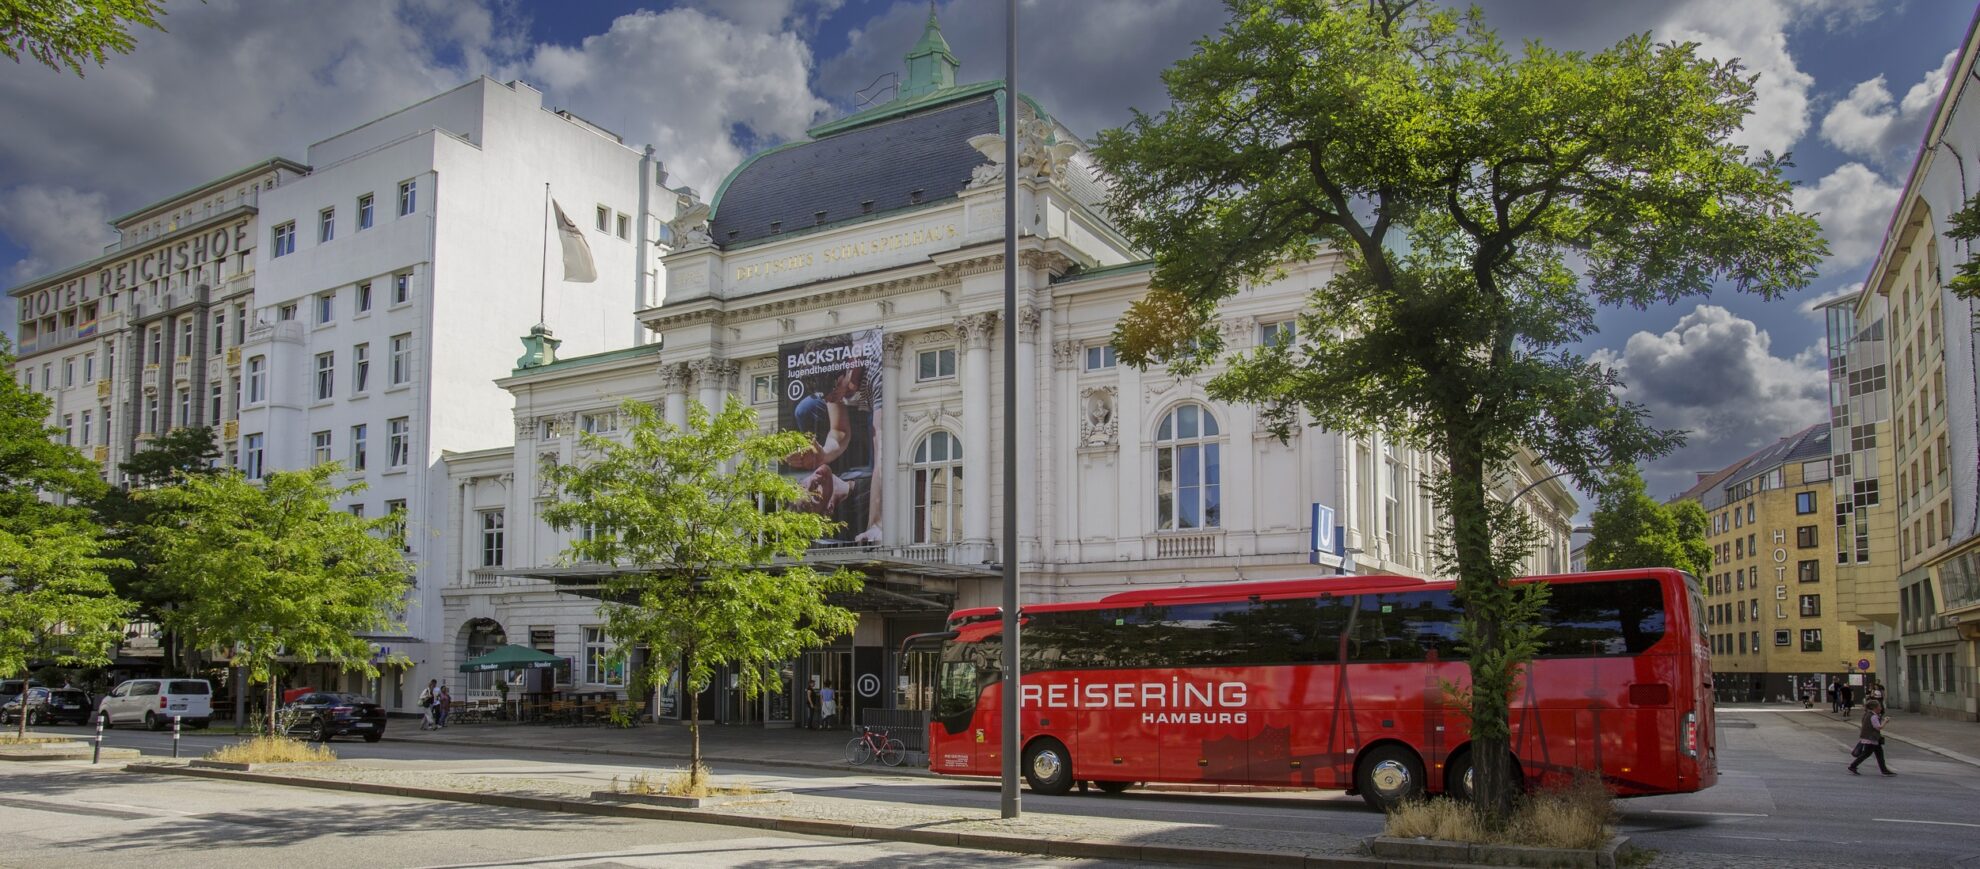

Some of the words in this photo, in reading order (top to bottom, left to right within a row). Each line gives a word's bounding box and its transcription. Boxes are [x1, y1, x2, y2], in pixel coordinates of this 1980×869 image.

[23, 276, 89, 320] HOTEL
[99, 220, 248, 295] REICHSHOF
[736, 253, 814, 281] DEUTSCHES
[787, 342, 874, 369] BACKSTAGE
[1320, 509, 1332, 546] U
[1773, 528, 1788, 619] HOTEL
[1142, 712, 1248, 724] HAMBURG
